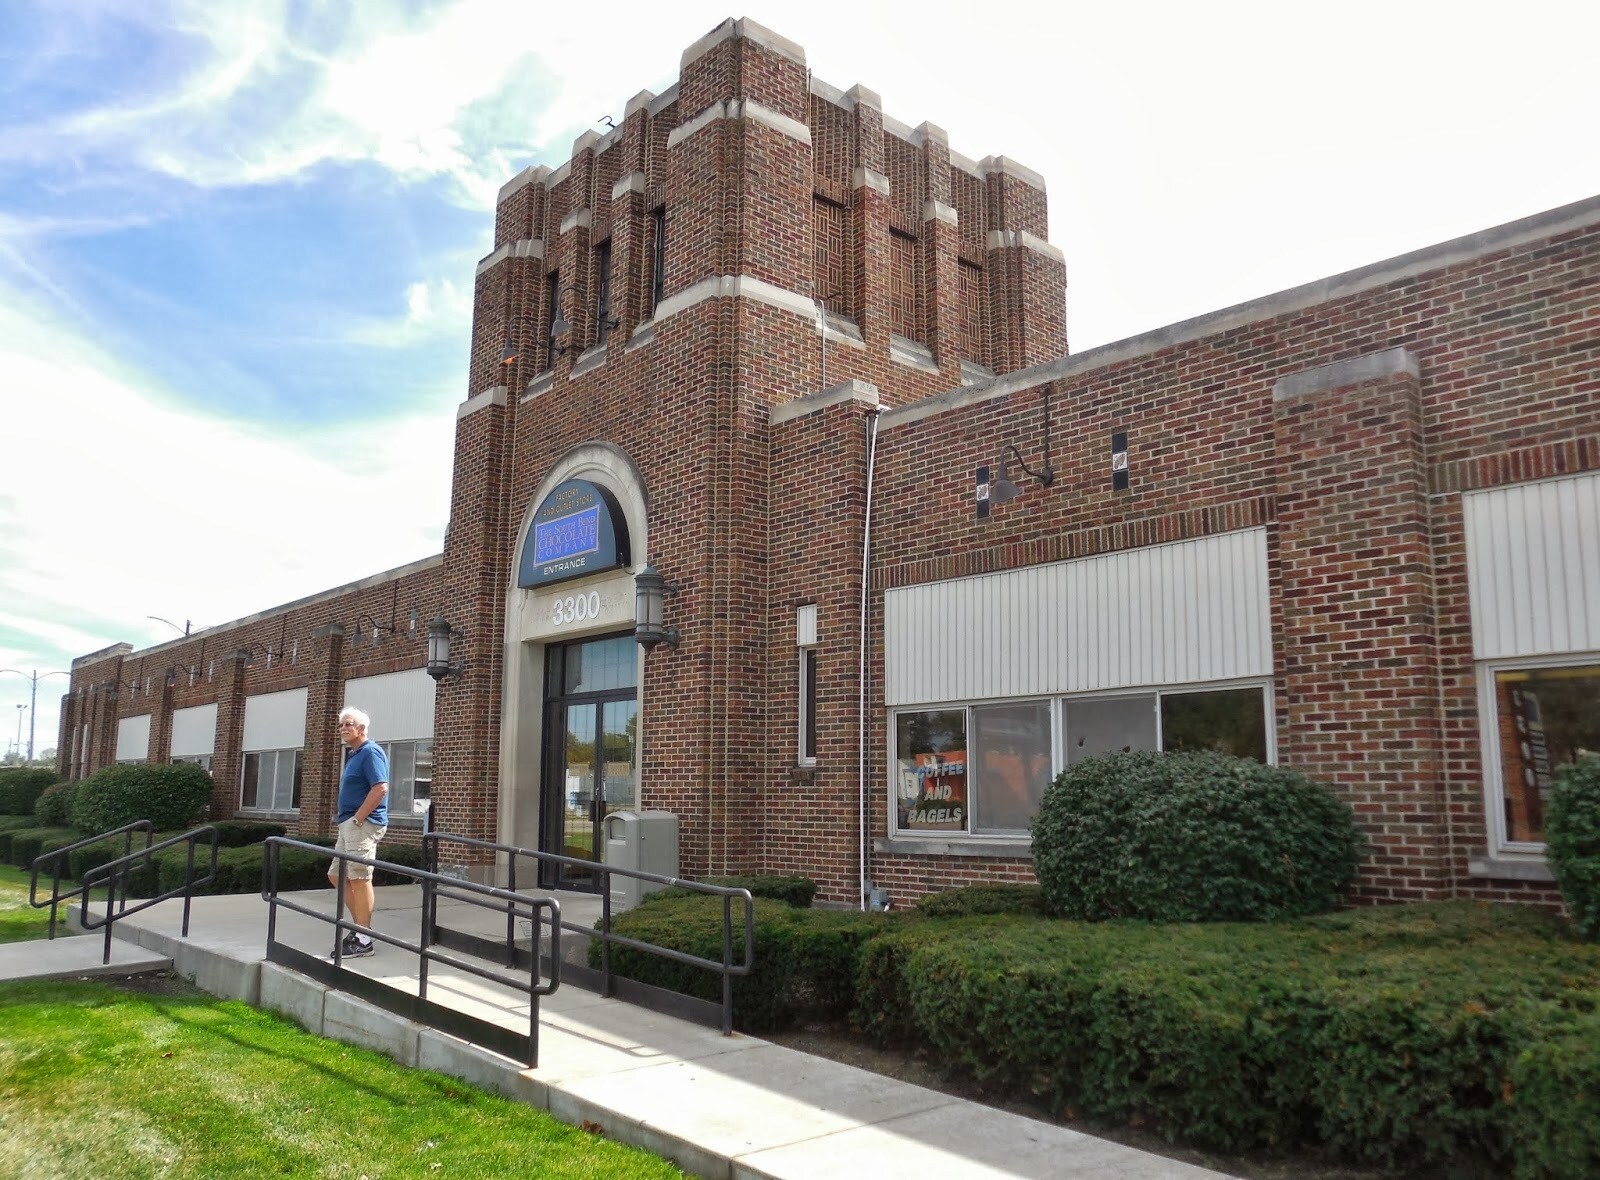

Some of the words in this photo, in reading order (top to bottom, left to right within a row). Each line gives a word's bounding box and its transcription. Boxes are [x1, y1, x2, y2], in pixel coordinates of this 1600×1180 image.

[538, 524, 596, 550] CHOCOLATE
[538, 536, 596, 559] COMPANY
[543, 557, 586, 575] ENTRANCE
[553, 590, 601, 626] 3300
[918, 763, 964, 779] COFFEE
[924, 785, 952, 801] AND
[907, 807, 962, 824] BAGELS
